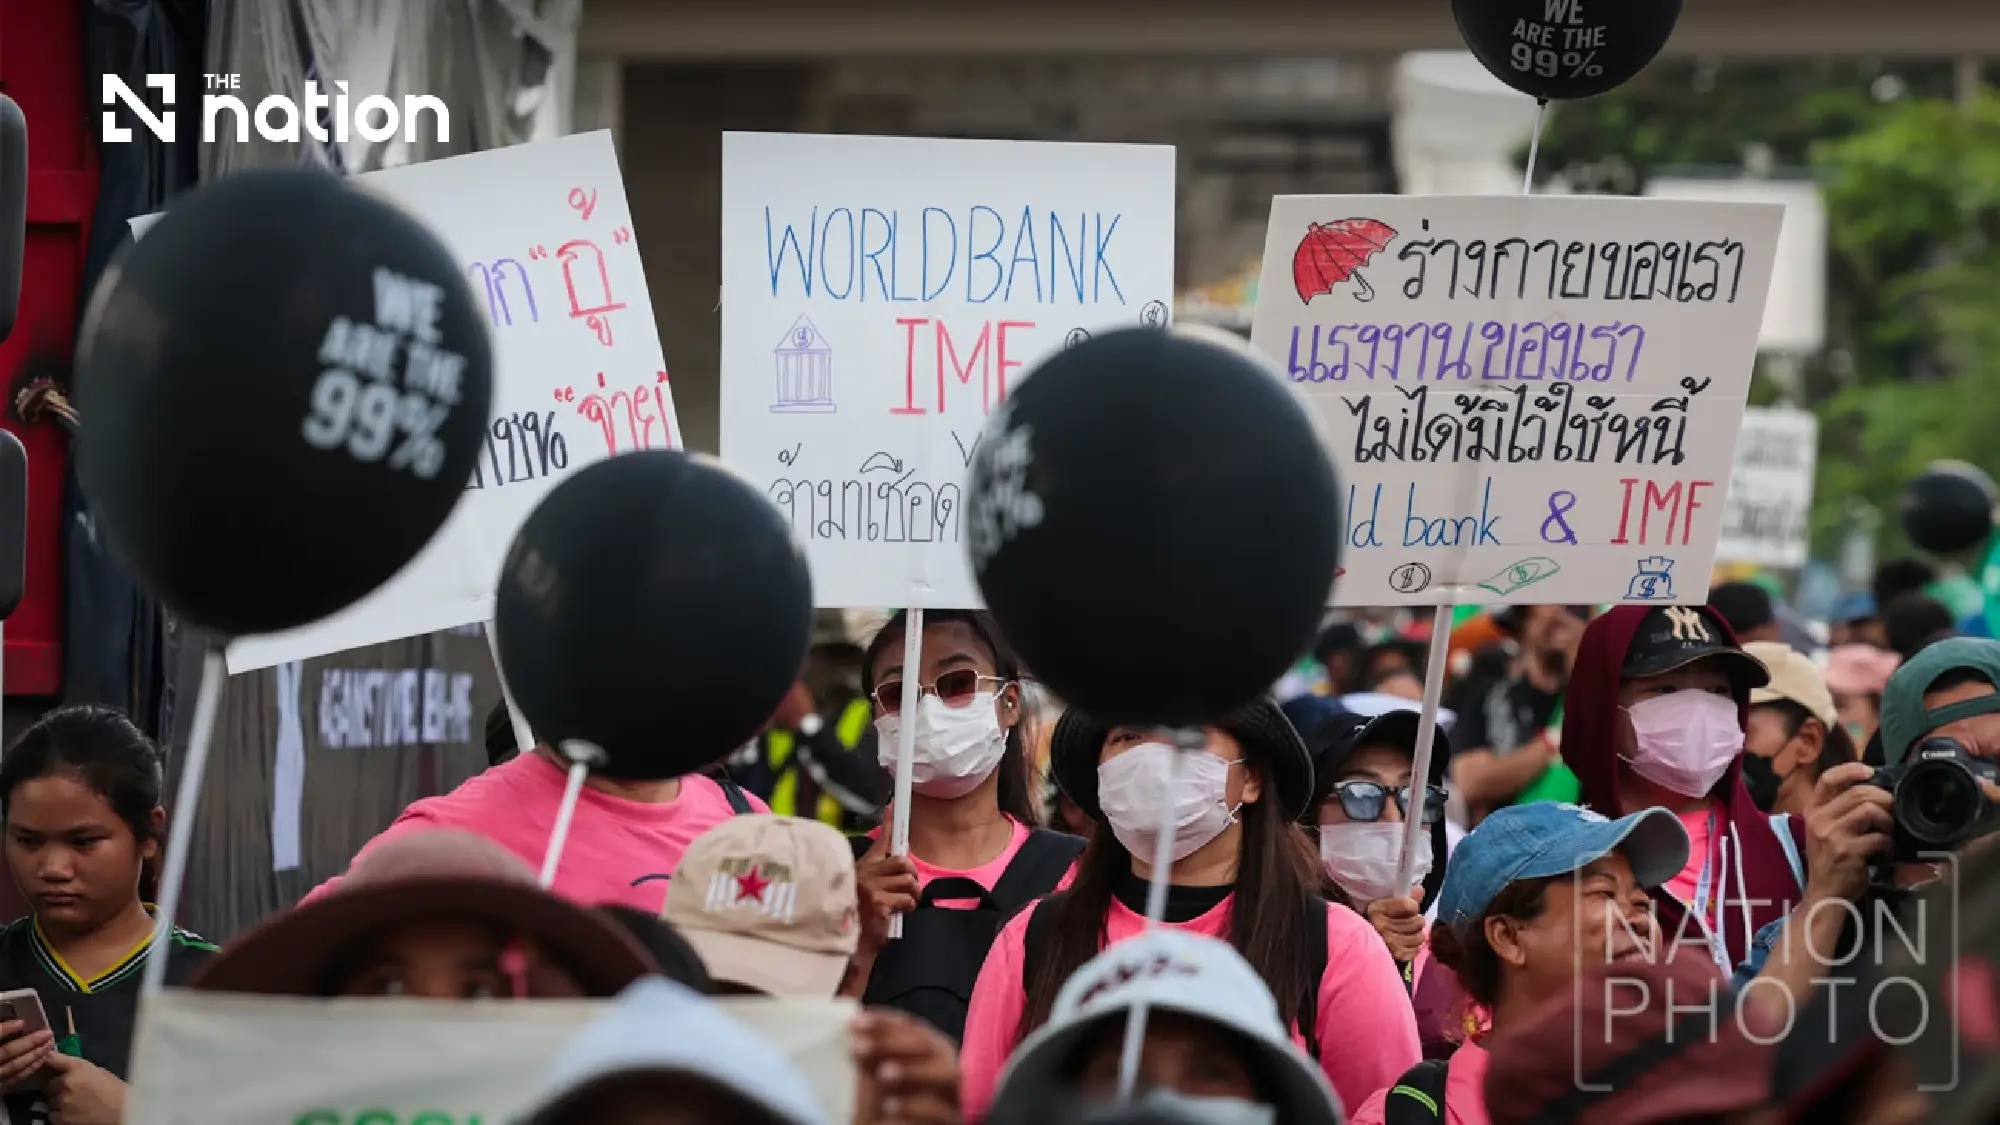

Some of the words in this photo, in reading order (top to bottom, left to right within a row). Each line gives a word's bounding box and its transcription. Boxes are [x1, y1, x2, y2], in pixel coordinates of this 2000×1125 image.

[1511, 17, 1556, 48] ARE
[1562, 25, 1607, 50] THE
[1543, 0, 1584, 25] WE
[1510, 42, 1604, 79] 99%
[1398, 218, 1745, 303] ร่างกายของเรา
[371, 264, 446, 345] WE
[889, 317, 1036, 417] IMF
[1288, 320, 1646, 383] แรงงานของเรา
[302, 367, 447, 480] 99%
[1402, 477, 1501, 547] bank
[1539, 490, 1579, 546] &
[1610, 478, 1714, 546] IMF
